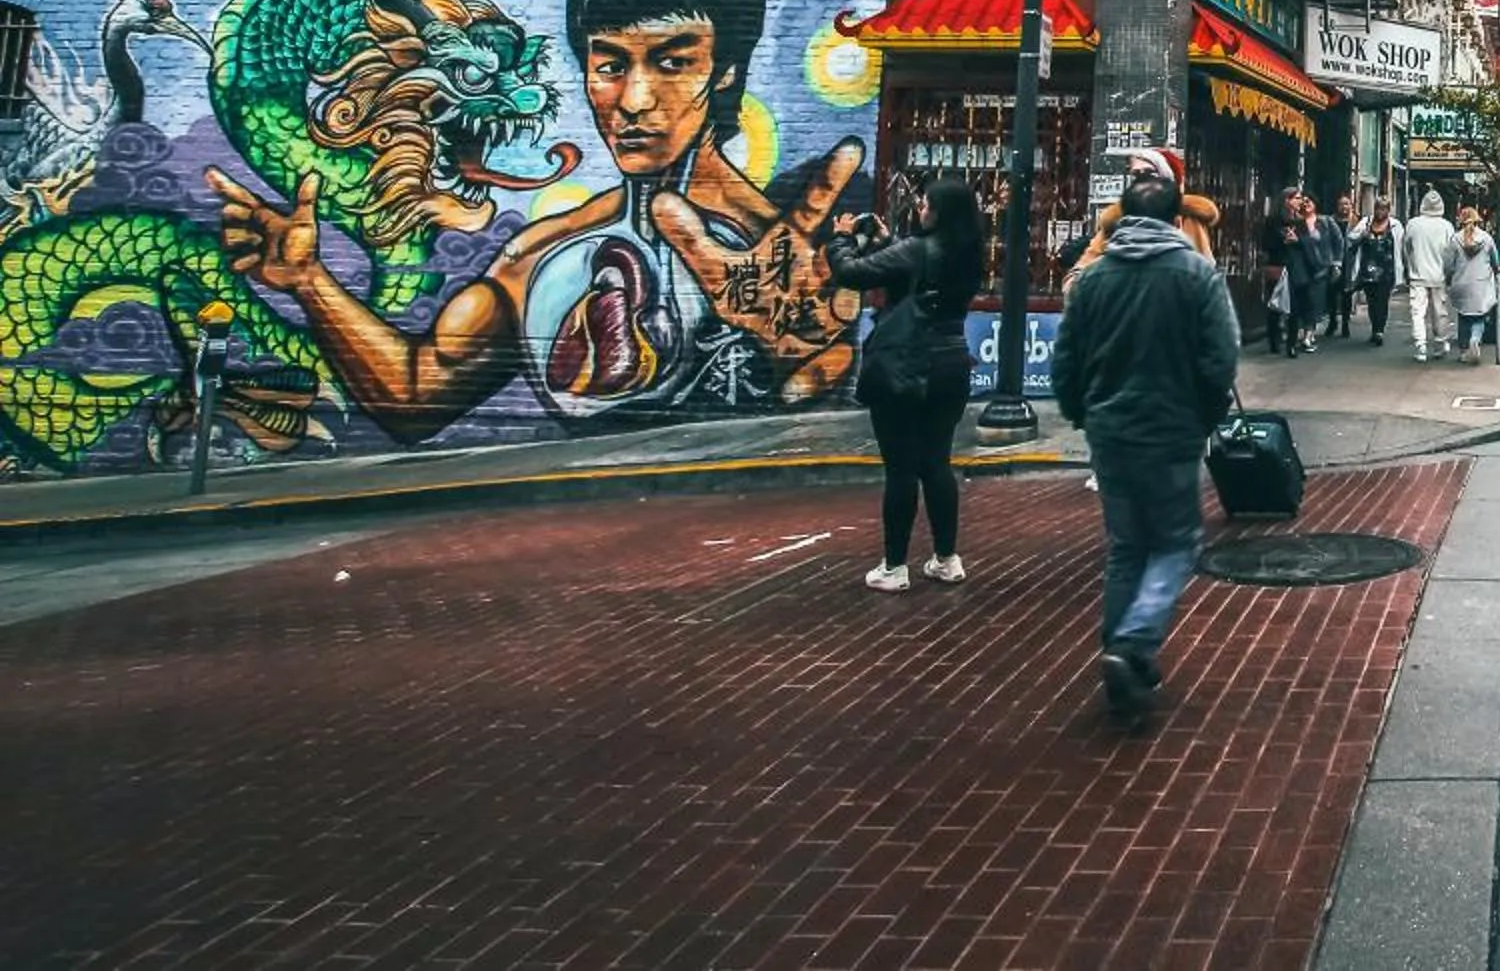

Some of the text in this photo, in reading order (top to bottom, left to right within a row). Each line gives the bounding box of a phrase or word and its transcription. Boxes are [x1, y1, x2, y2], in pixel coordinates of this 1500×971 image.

[1319, 13, 1337, 29] te
[1318, 30, 1431, 71] WOK SHOP
